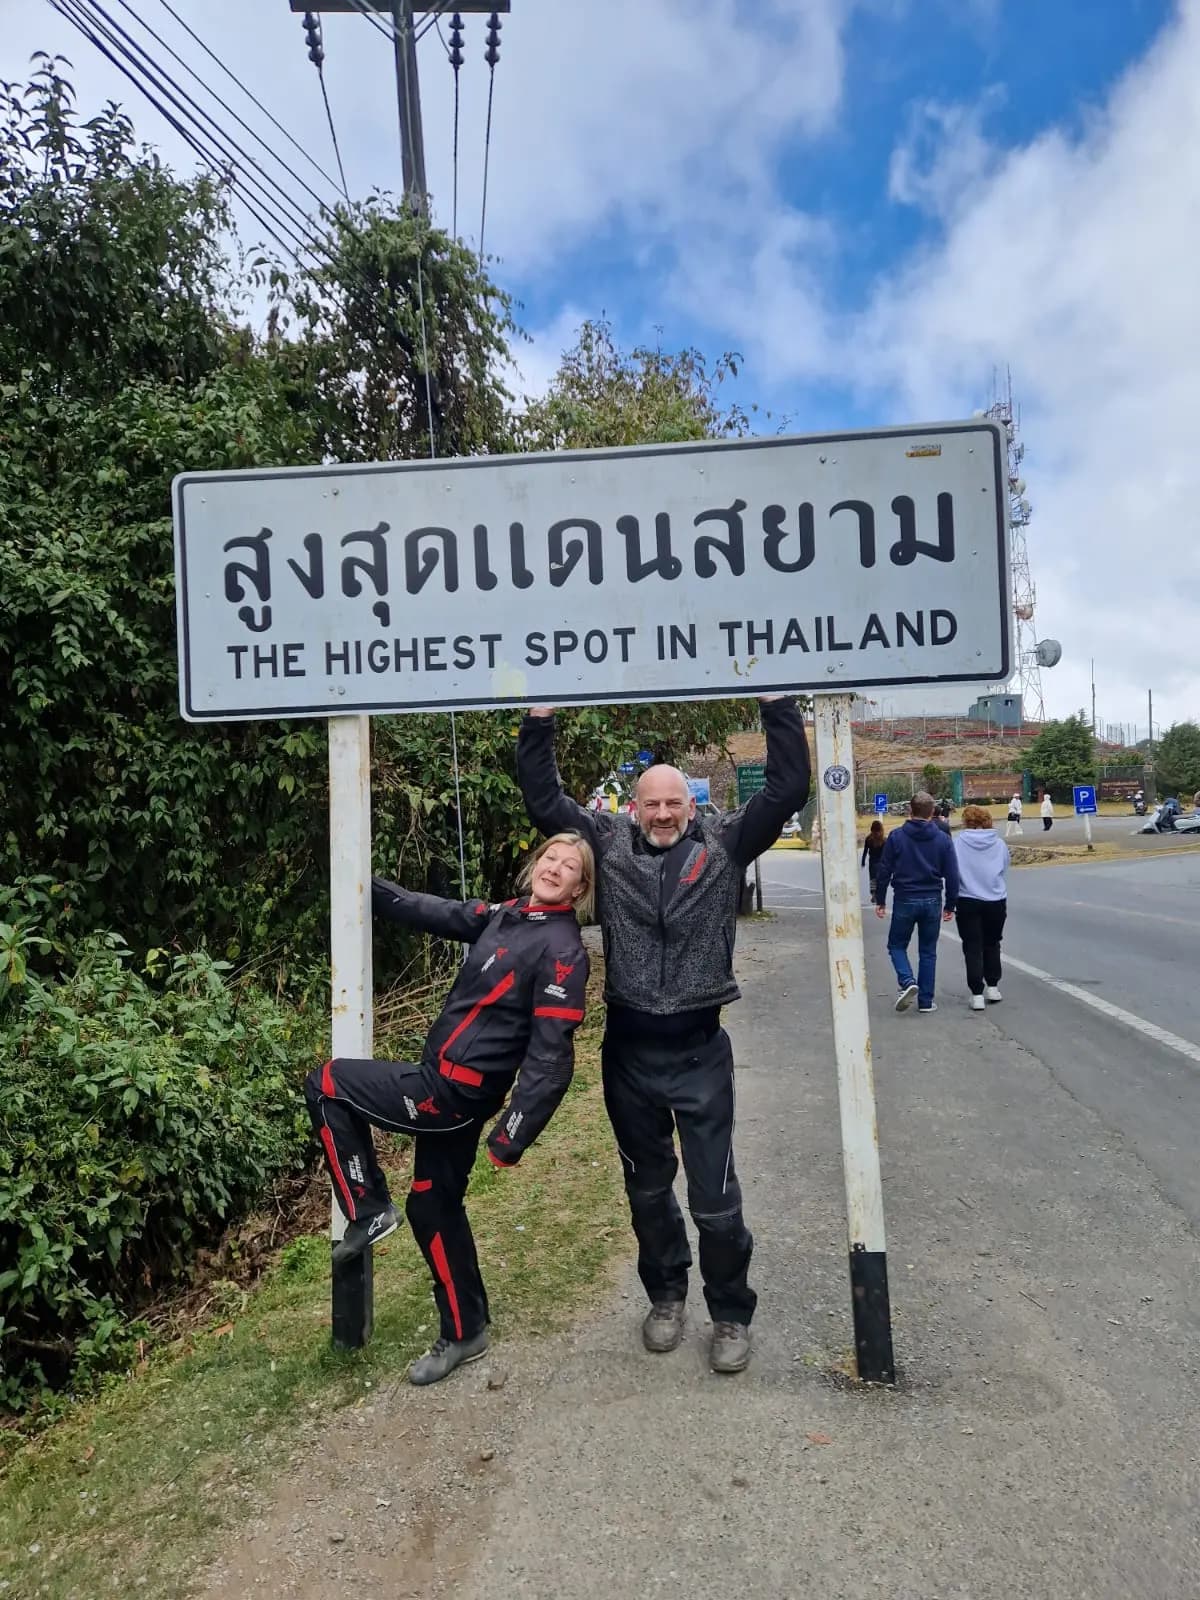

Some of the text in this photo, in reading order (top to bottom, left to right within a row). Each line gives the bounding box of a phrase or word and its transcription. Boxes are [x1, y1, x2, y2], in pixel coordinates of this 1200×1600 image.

[223, 491, 955, 633] สูงสุดแดนสยาม
[226, 609, 958, 680] THE HIGHEST SPOT IN THAILAND
[1079, 790, 1090, 803] P
